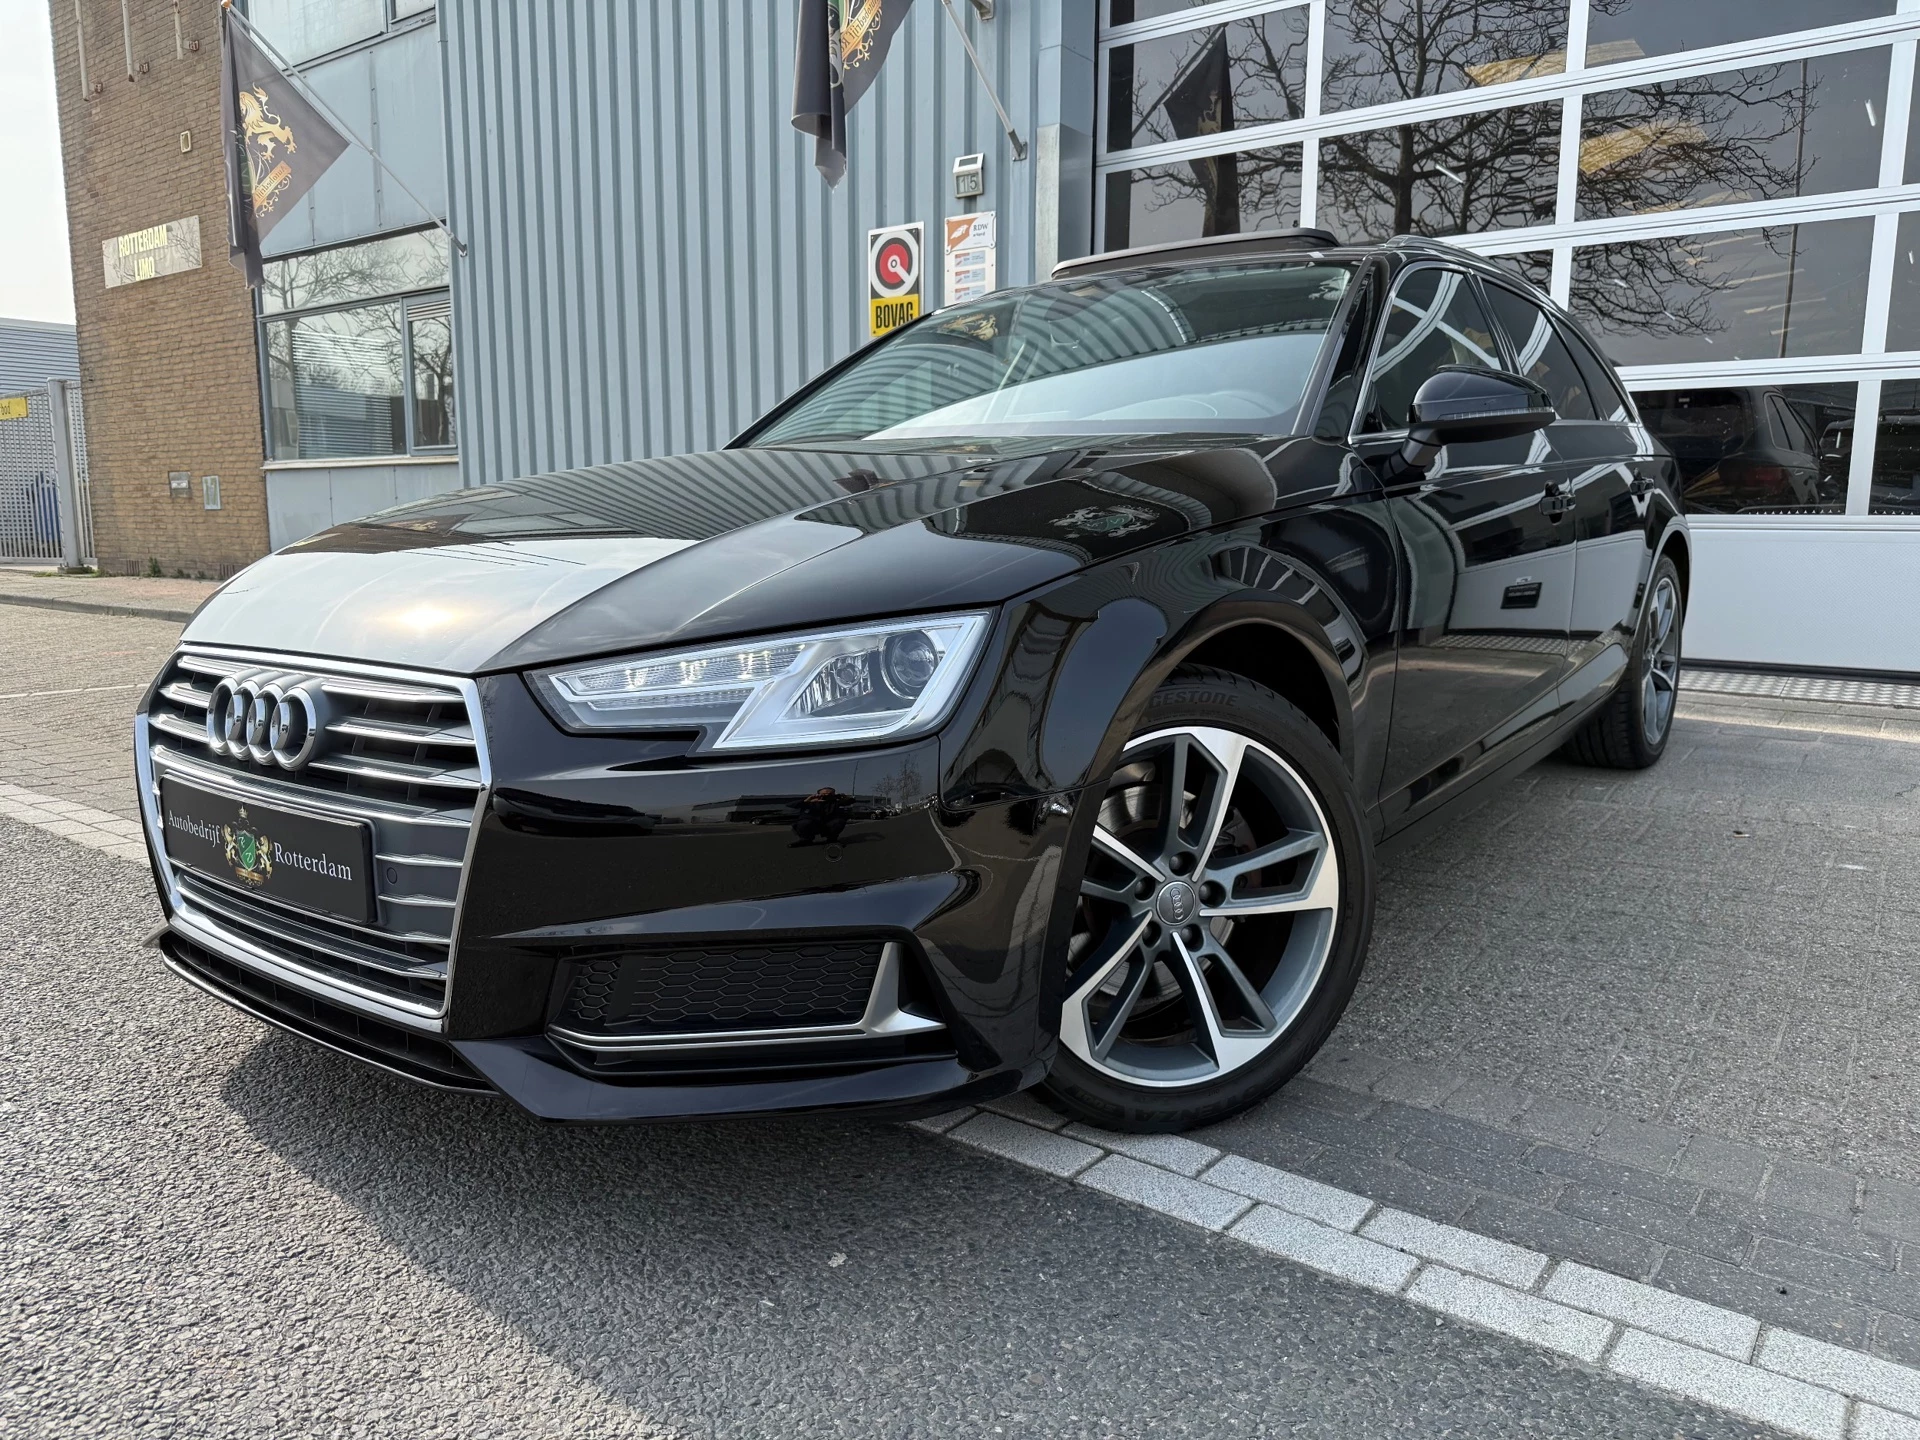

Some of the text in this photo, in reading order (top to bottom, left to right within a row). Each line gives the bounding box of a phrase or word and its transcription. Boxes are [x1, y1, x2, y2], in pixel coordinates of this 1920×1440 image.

[118, 224, 168, 257] ROTTERDAM
[134, 256, 155, 281] LIMO
[875, 301, 914, 329] BOVAG
[0, 400, 11, 416] bod
[1149, 690, 1239, 709] GESTONE
[168, 809, 353, 881] Autobedrijf Rotterdam
